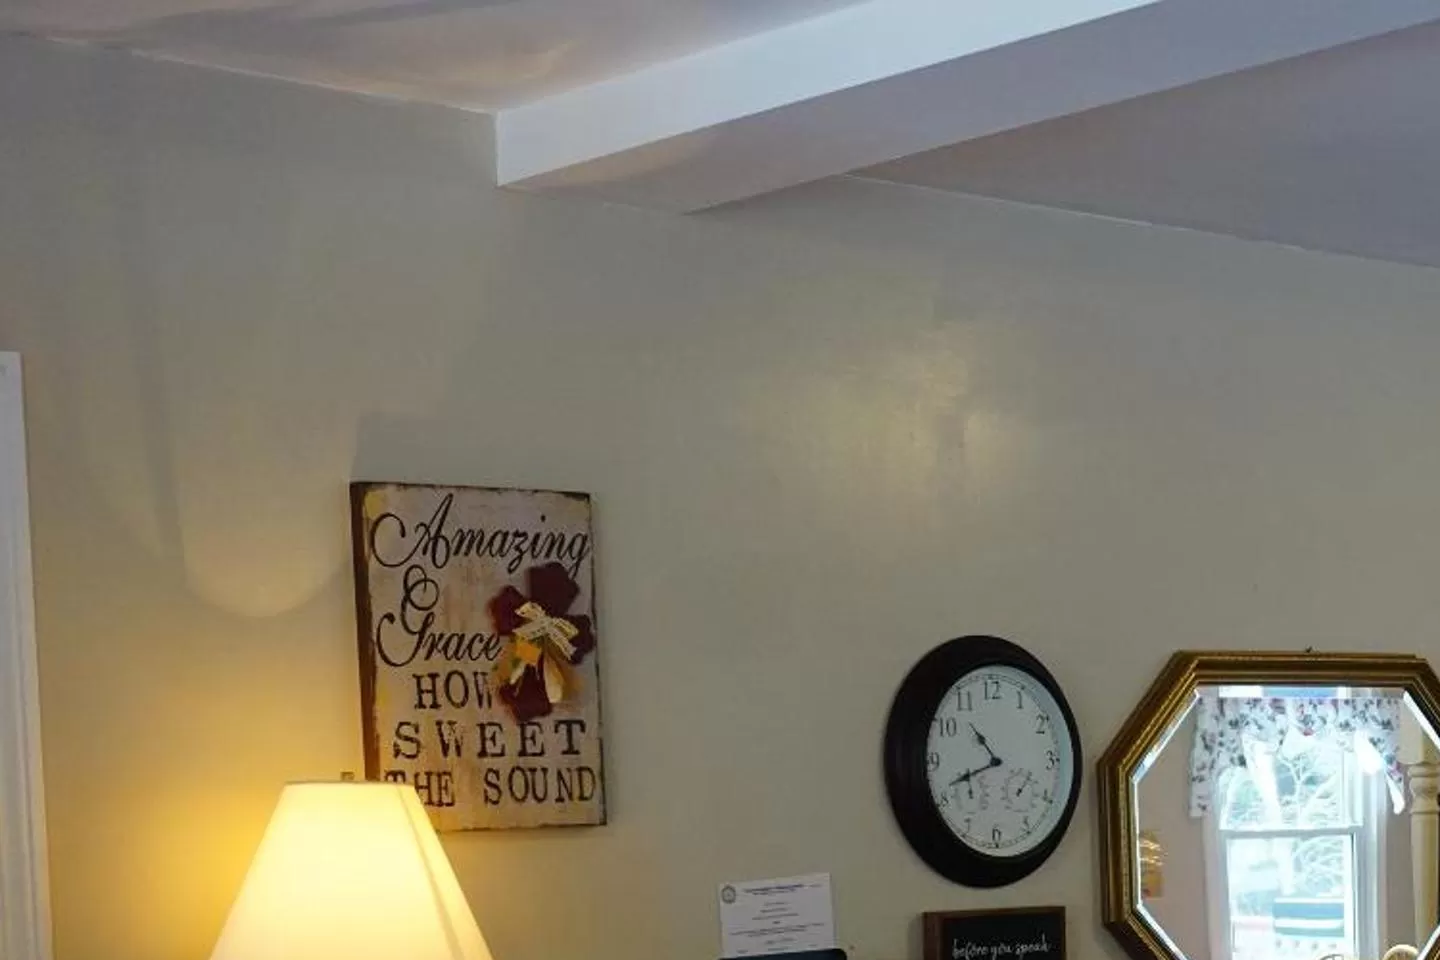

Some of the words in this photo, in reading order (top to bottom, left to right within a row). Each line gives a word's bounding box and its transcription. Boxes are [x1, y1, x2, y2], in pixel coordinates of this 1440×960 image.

[370, 494, 589, 579] Amazing
[376, 564, 502, 667] Grace
[413, 670, 493, 710] HOW
[957, 690, 973, 712] 11
[984, 680, 1001, 700] 12
[1016, 691, 1024, 710] 1
[393, 719, 586, 760] SWEET
[939, 717, 957, 737] 10
[1036, 715, 1046, 735] 2
[483, 766, 596, 805] SOUND
